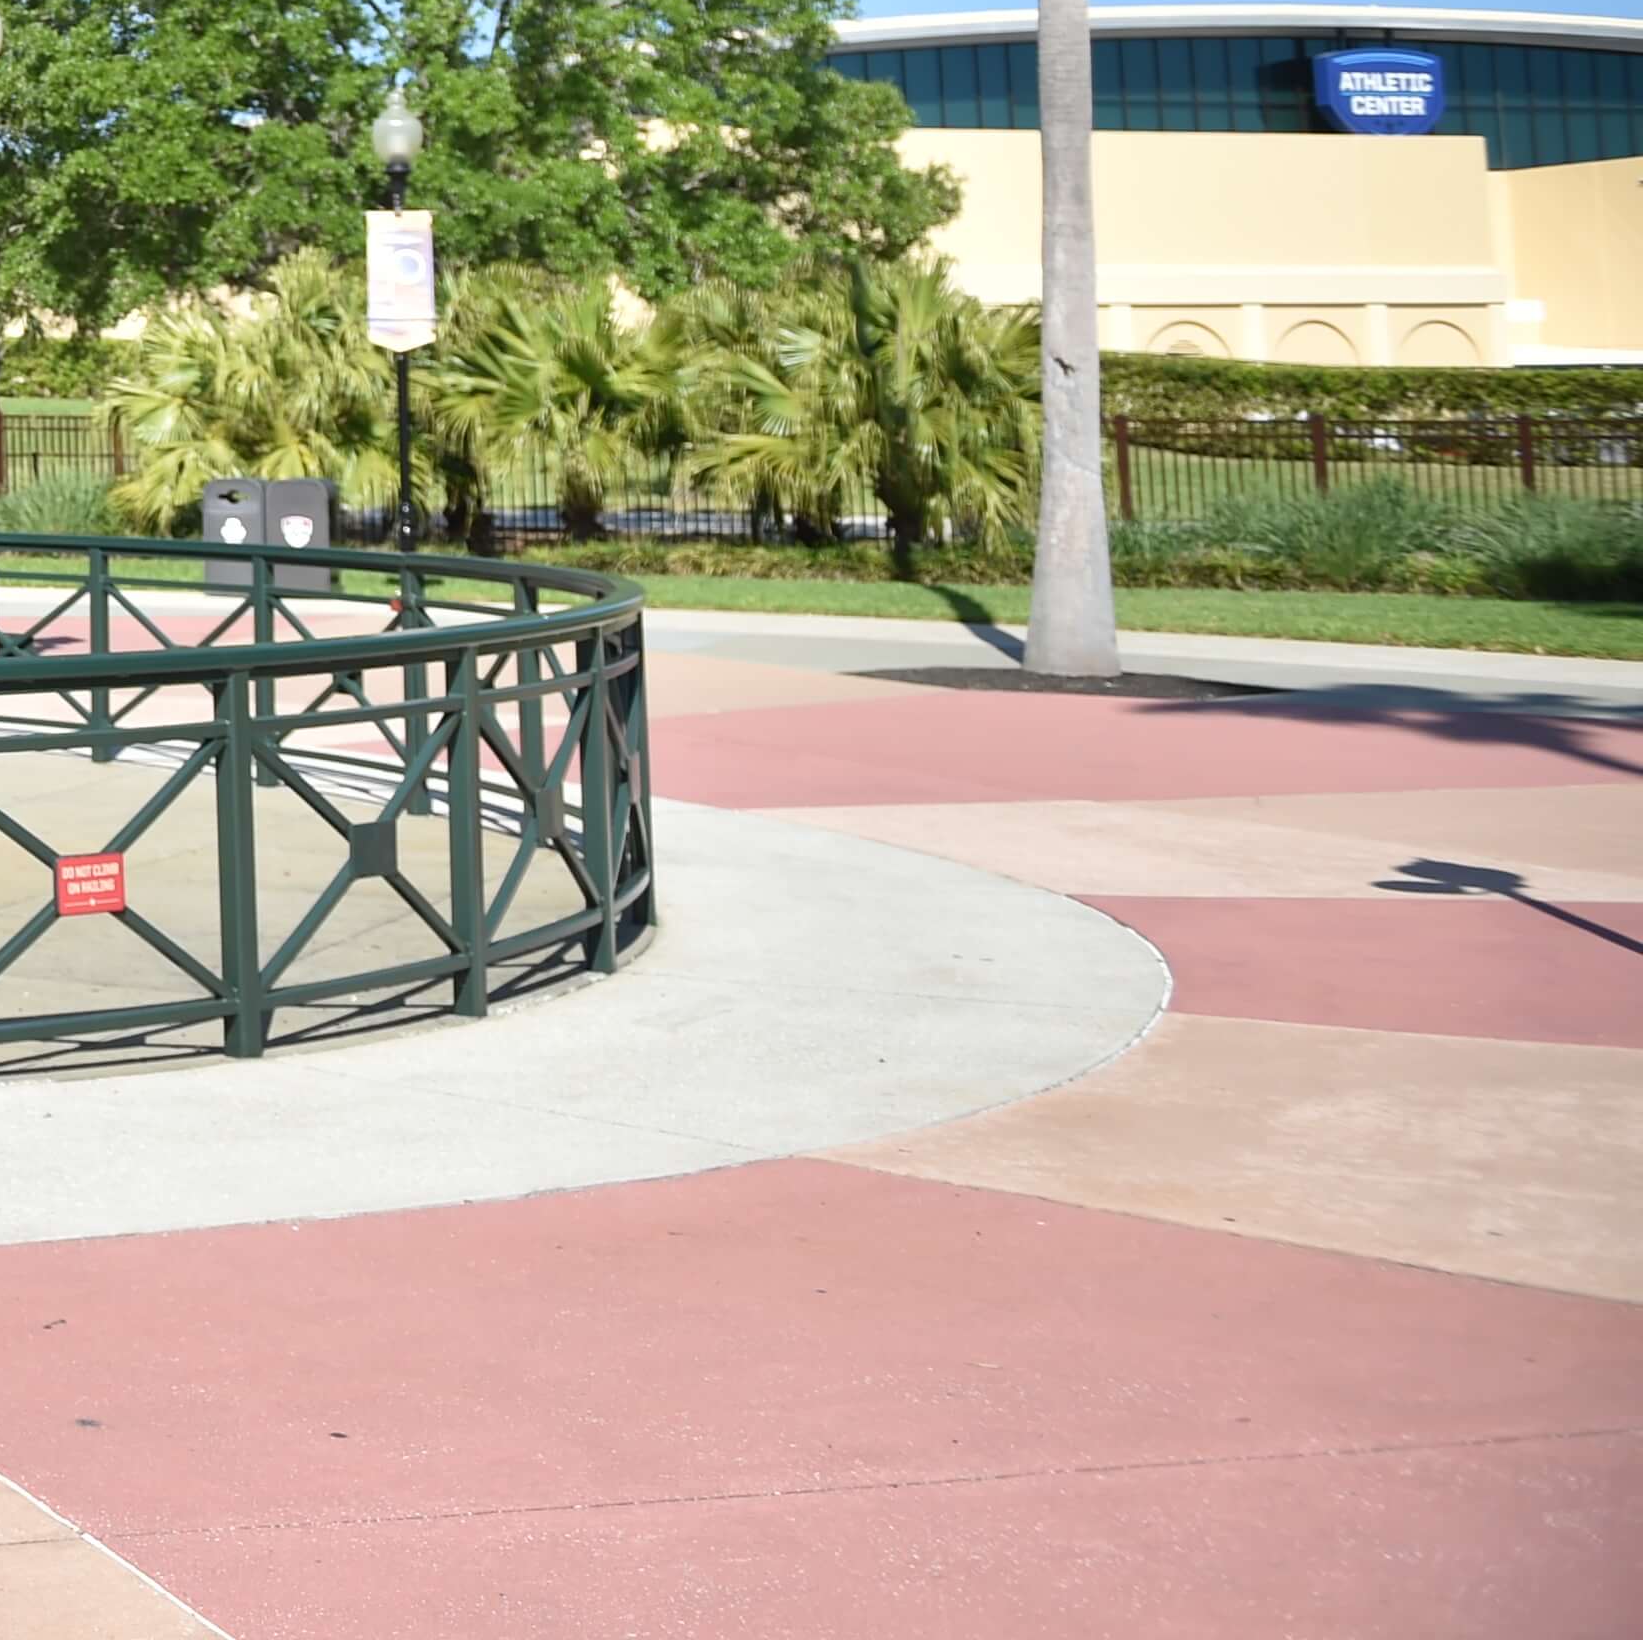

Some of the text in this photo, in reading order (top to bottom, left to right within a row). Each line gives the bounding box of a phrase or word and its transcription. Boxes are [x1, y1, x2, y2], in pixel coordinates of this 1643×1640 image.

[1339, 71, 1434, 92] ATHLETIC
[1350, 95, 1427, 116] CENTER
[75, 864, 92, 878] NOT
